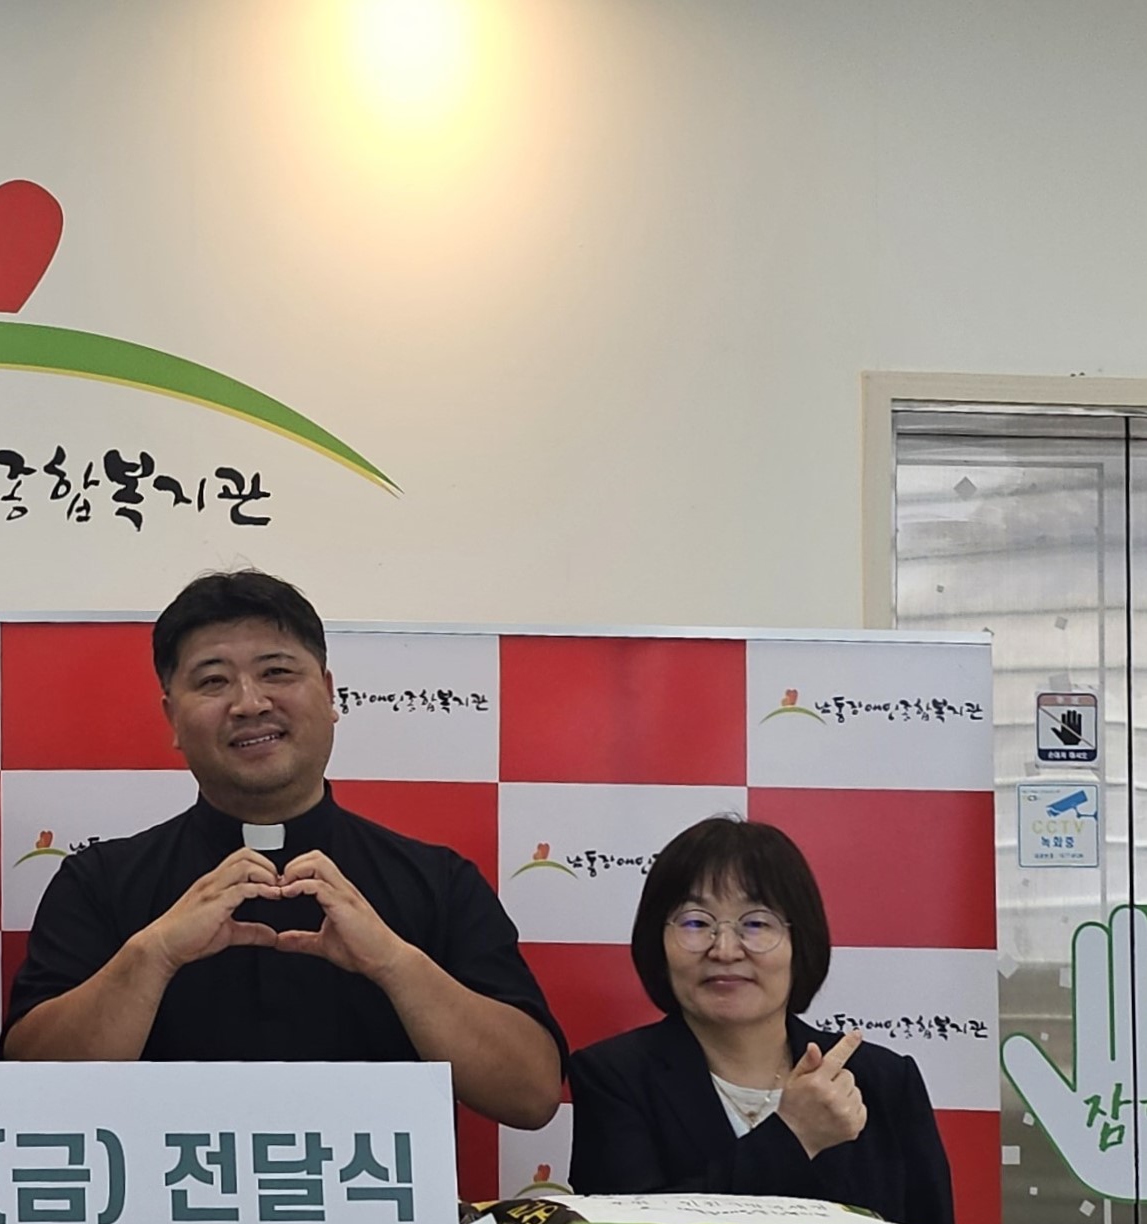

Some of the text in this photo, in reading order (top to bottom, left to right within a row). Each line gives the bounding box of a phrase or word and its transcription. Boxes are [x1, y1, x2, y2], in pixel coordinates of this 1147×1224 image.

[332, 687, 489, 714] 동장애인종합복지관
[815, 696, 984, 724] 남동장애인종합복지관
[1032, 820, 1086, 835] CCTV
[1084, 1083, 1147, 1152] 잠
[163, 1130, 417, 1223] 전달식
